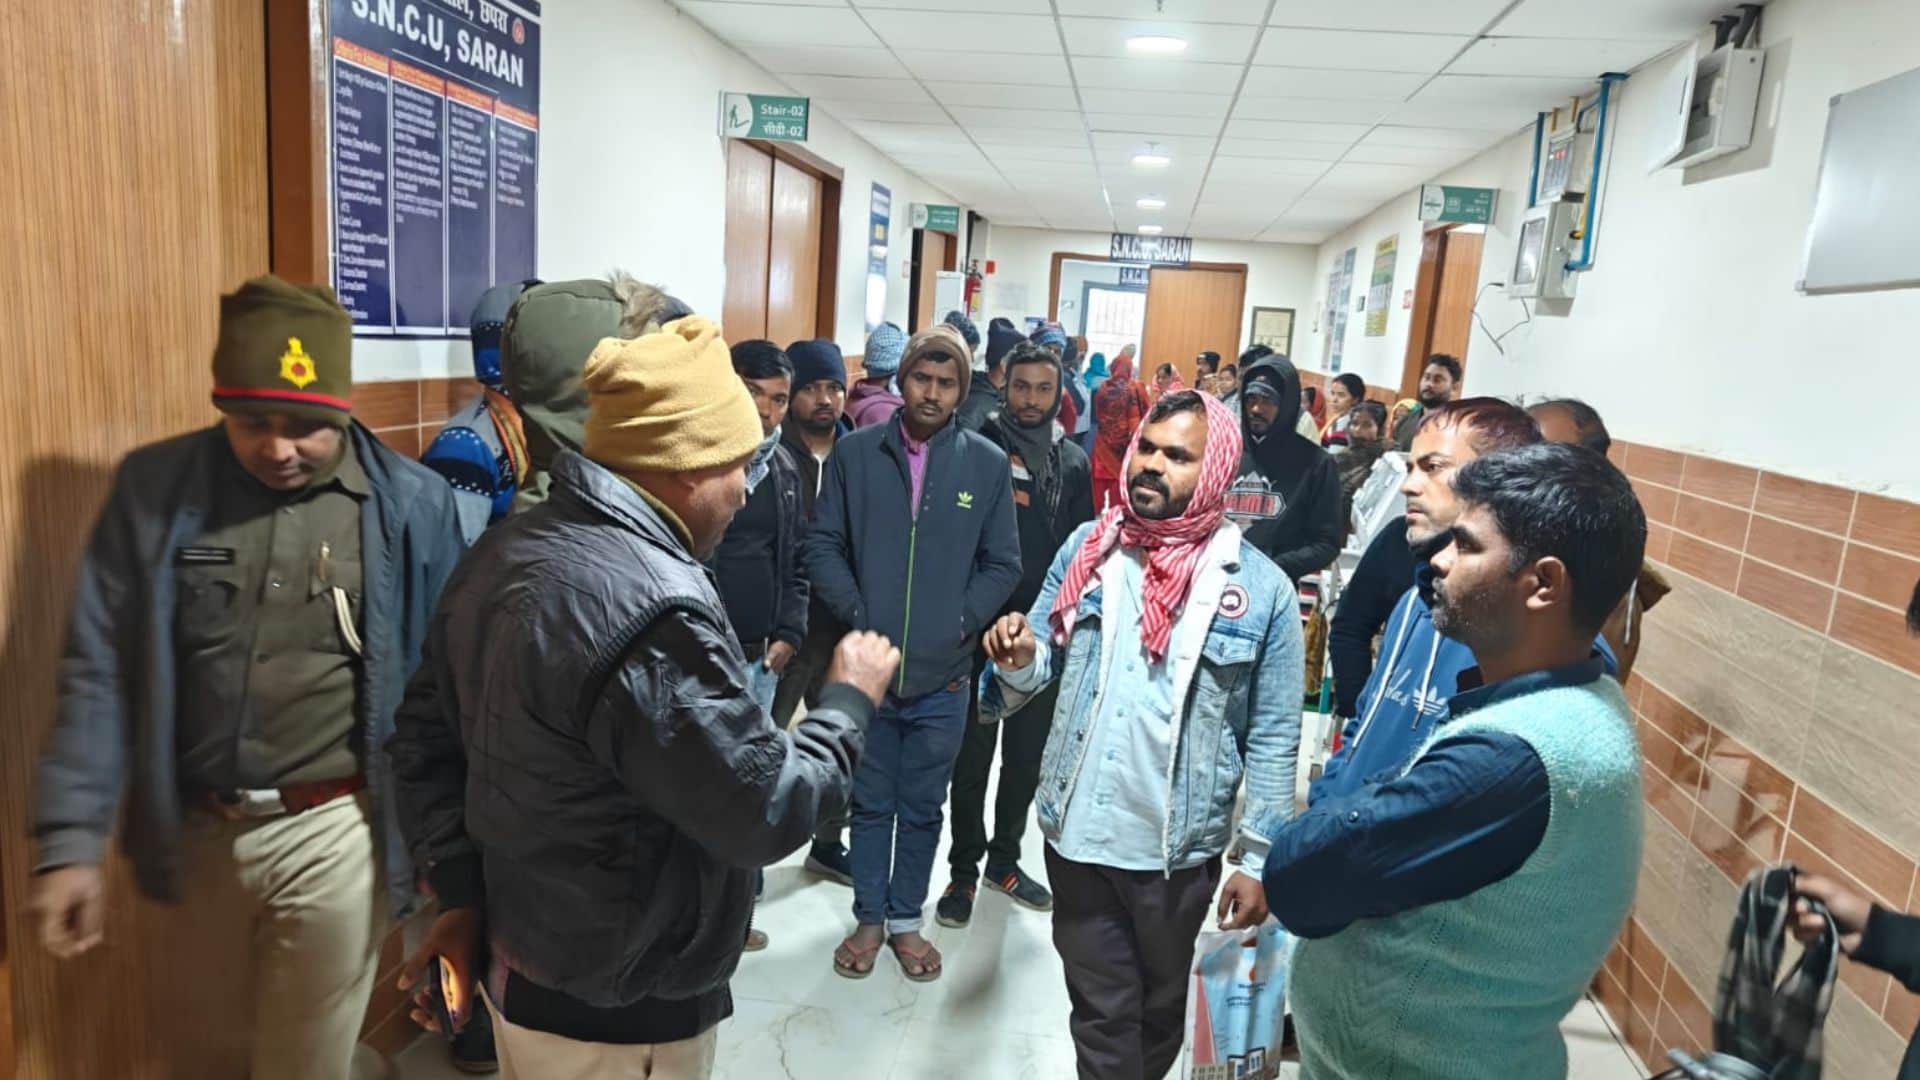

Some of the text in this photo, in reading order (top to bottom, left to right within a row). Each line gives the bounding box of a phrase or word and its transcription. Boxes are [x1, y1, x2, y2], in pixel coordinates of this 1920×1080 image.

[456, 29, 524, 88] SARAN
[760, 103, 805, 117] Stair-02
[1153, 236, 1190, 262] SARAN
